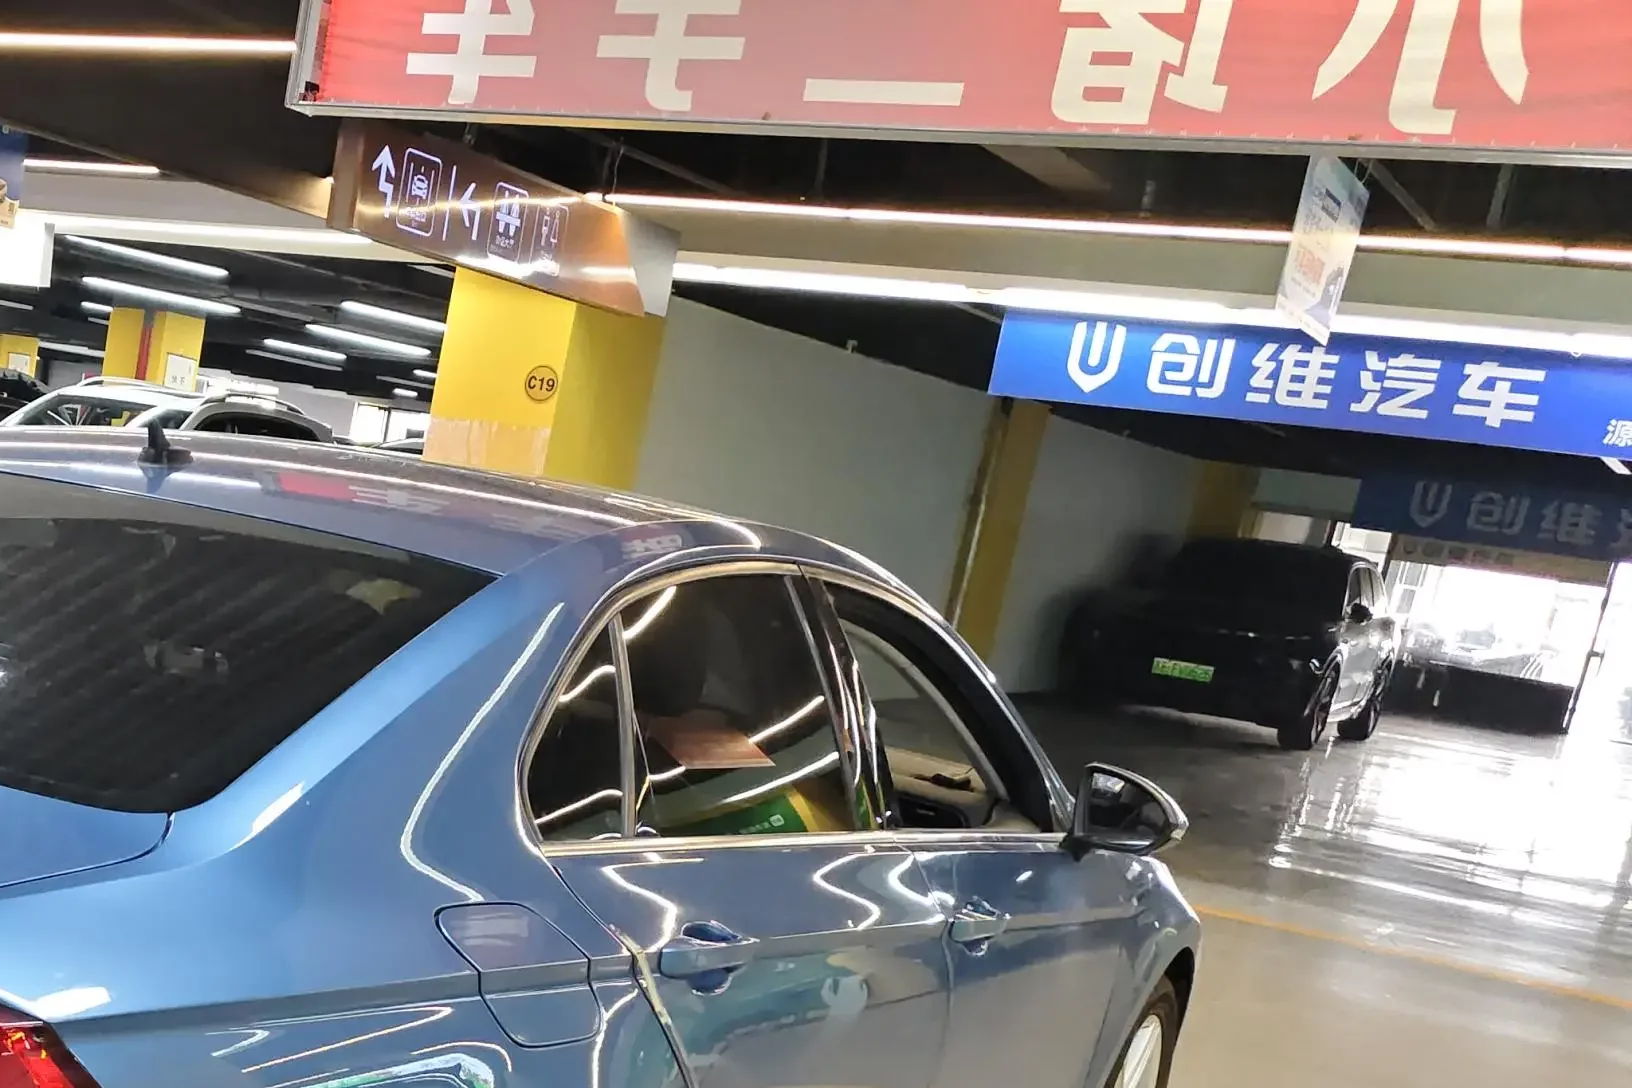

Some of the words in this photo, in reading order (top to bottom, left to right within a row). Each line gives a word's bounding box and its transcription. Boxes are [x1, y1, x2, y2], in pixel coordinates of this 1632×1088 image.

[528, 375, 555, 392] C19
[1147, 331, 1548, 429] 创维汽车
